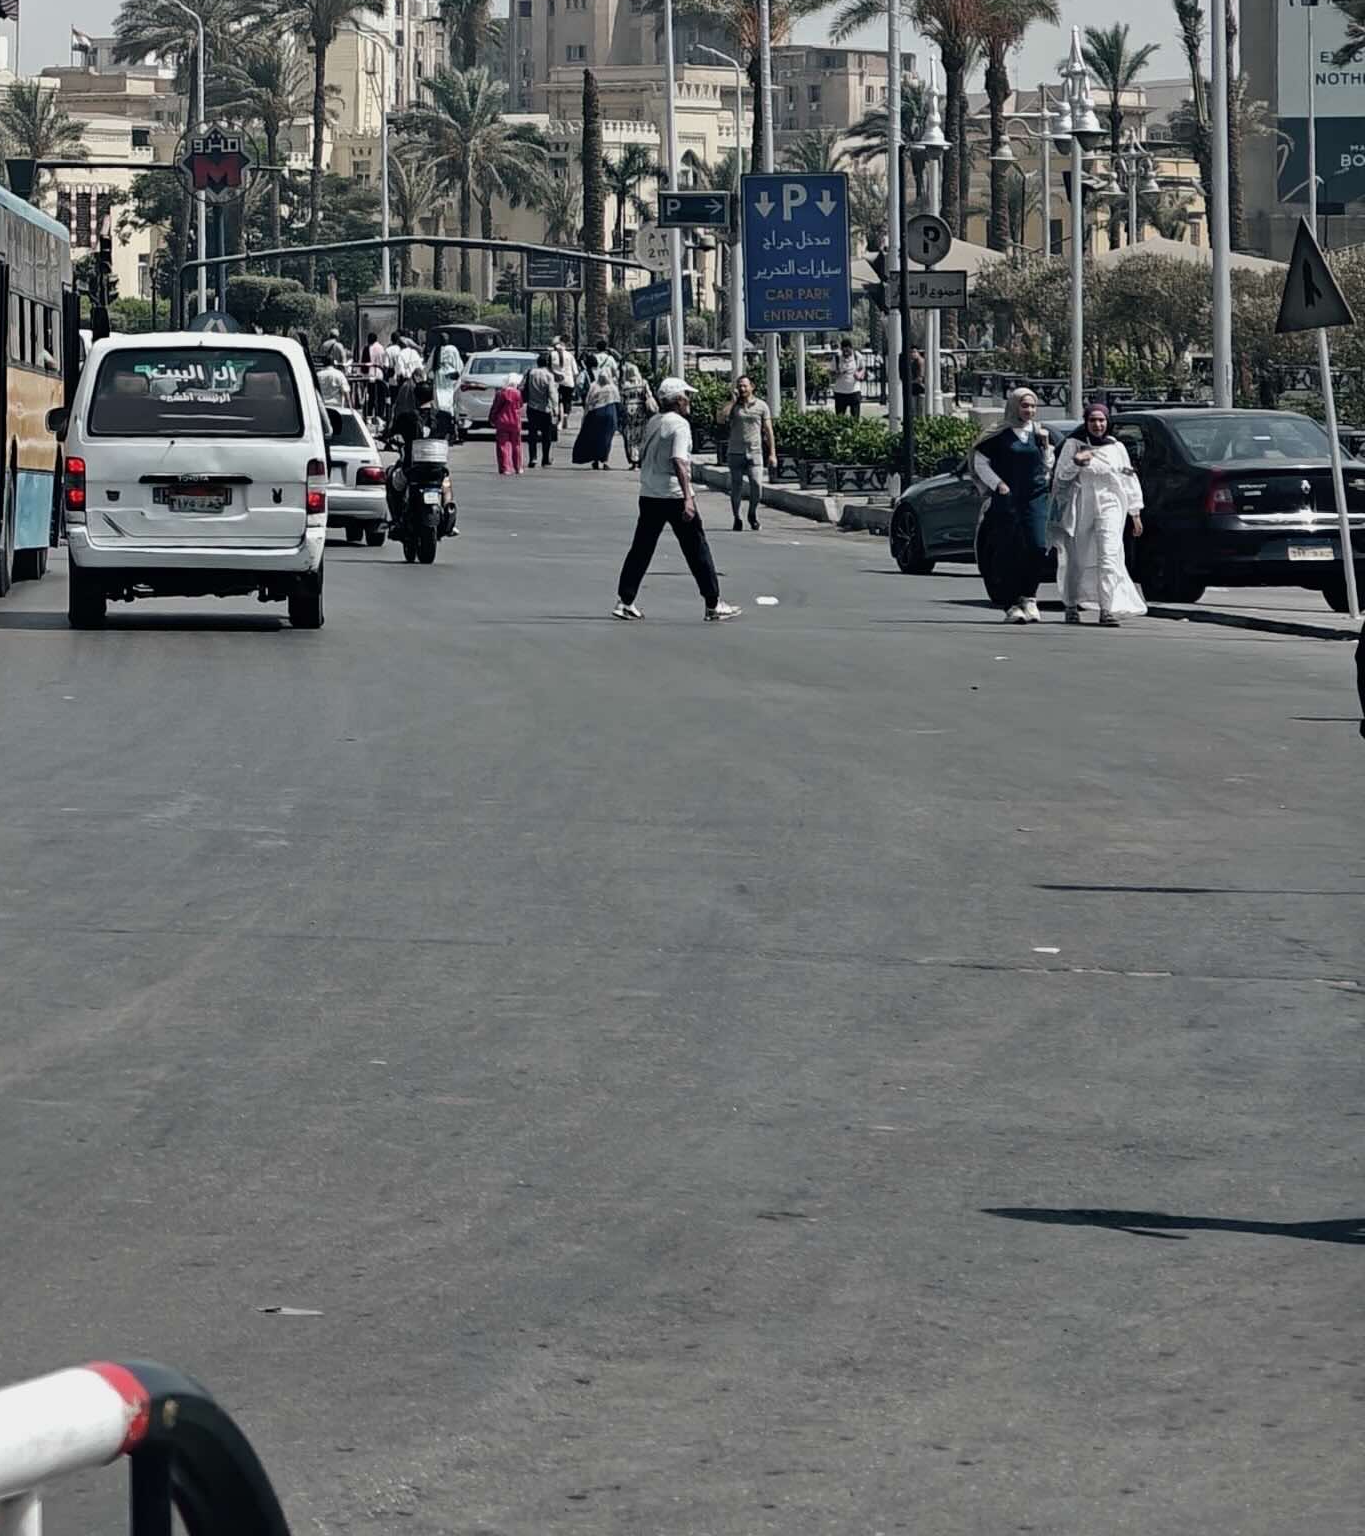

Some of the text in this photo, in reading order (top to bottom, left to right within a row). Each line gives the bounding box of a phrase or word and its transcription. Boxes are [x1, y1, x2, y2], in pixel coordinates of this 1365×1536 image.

[193, 133, 239, 153] مترو
[667, 199, 682, 216] P
[782, 183, 808, 221] P
[796, 230, 831, 248] مدخل
[921, 226, 940, 254] P
[753, 259, 842, 280] سيارات التحرير
[765, 287, 832, 302] CAR PARK
[763, 310, 833, 322] ENTRANCE
